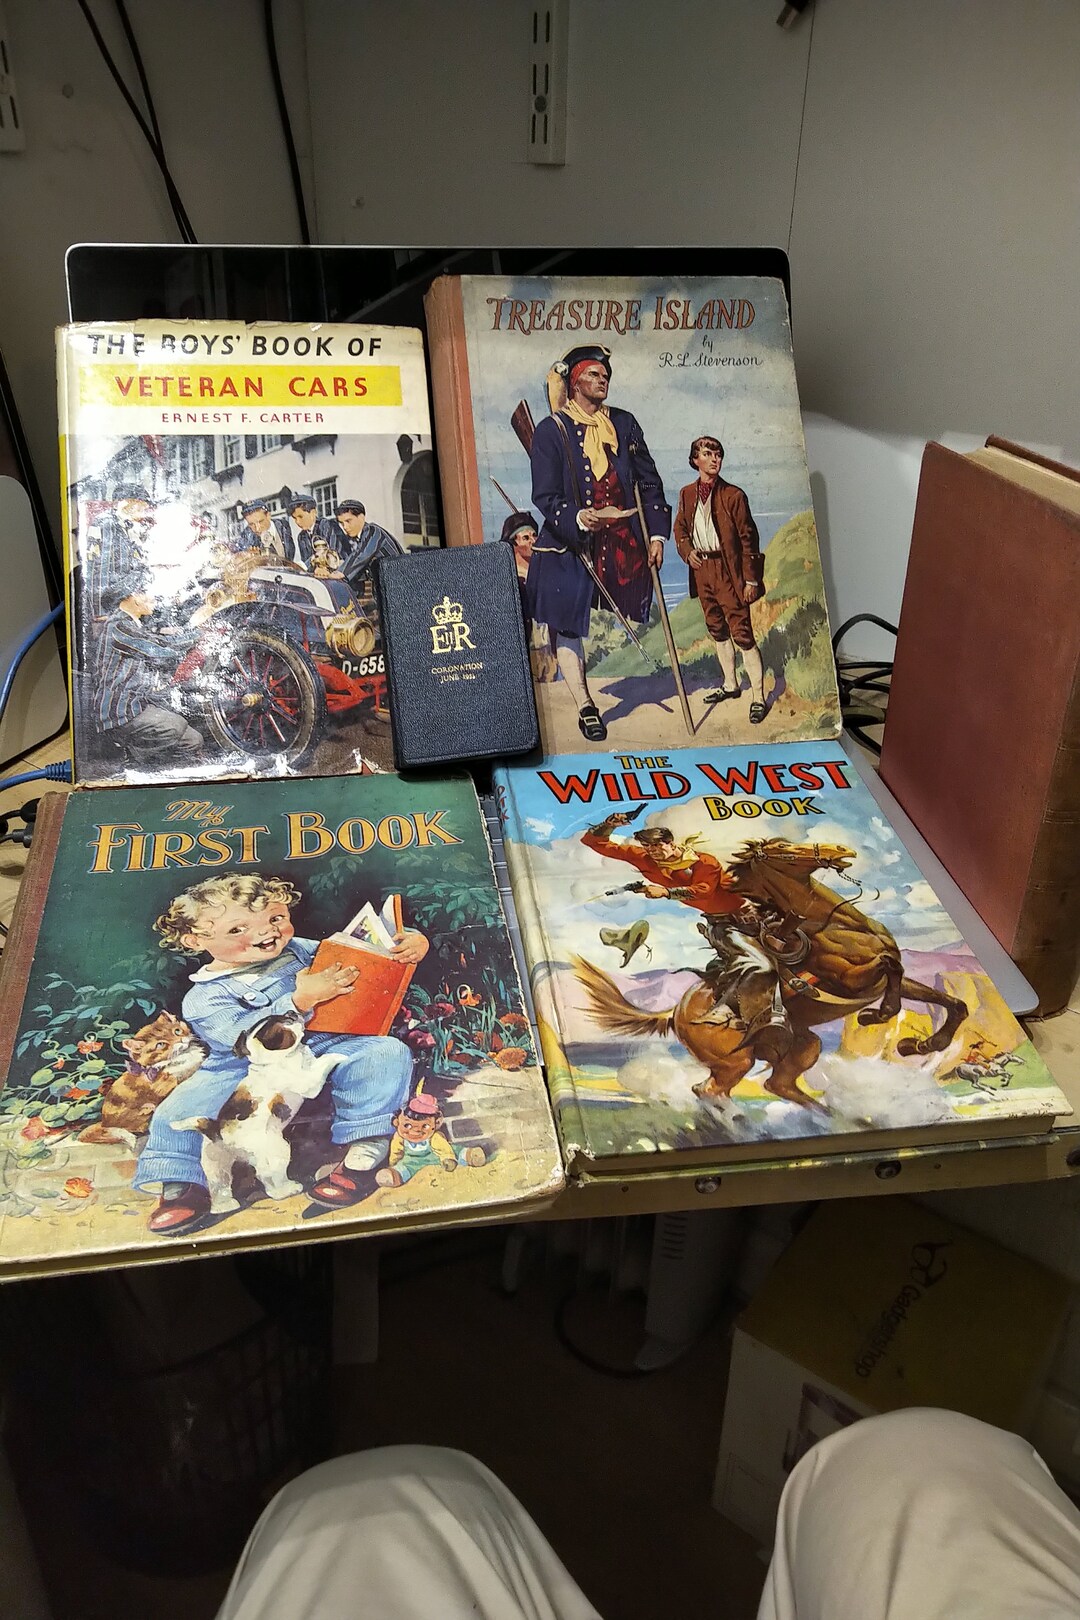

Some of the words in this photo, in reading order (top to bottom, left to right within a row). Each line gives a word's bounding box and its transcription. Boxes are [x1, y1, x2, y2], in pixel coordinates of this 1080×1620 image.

[486, 297, 642, 335] TREASURE
[652, 296, 756, 330] ISLAND
[87, 334, 146, 358] THE
[161, 334, 241, 356] BOYS'
[252, 336, 334, 356] BOOK
[348, 337, 382, 357] OF
[702, 335, 713, 351] by
[115, 376, 264, 398] VETERAN
[288, 376, 369, 397] CARS
[161, 412, 232, 424] ERNEST
[241, 412, 252, 423] F.
[260, 412, 324, 424] CARTER
[431, 662, 484, 674] CORONATION
[613, 755, 673, 770] THE
[537, 768, 692, 804] WILD
[695, 760, 852, 796] WEST
[162, 799, 234, 828] My
[702, 796, 826, 821] BOOK
[87, 821, 271, 874] FIRST
[283, 810, 465, 861] BOOK
